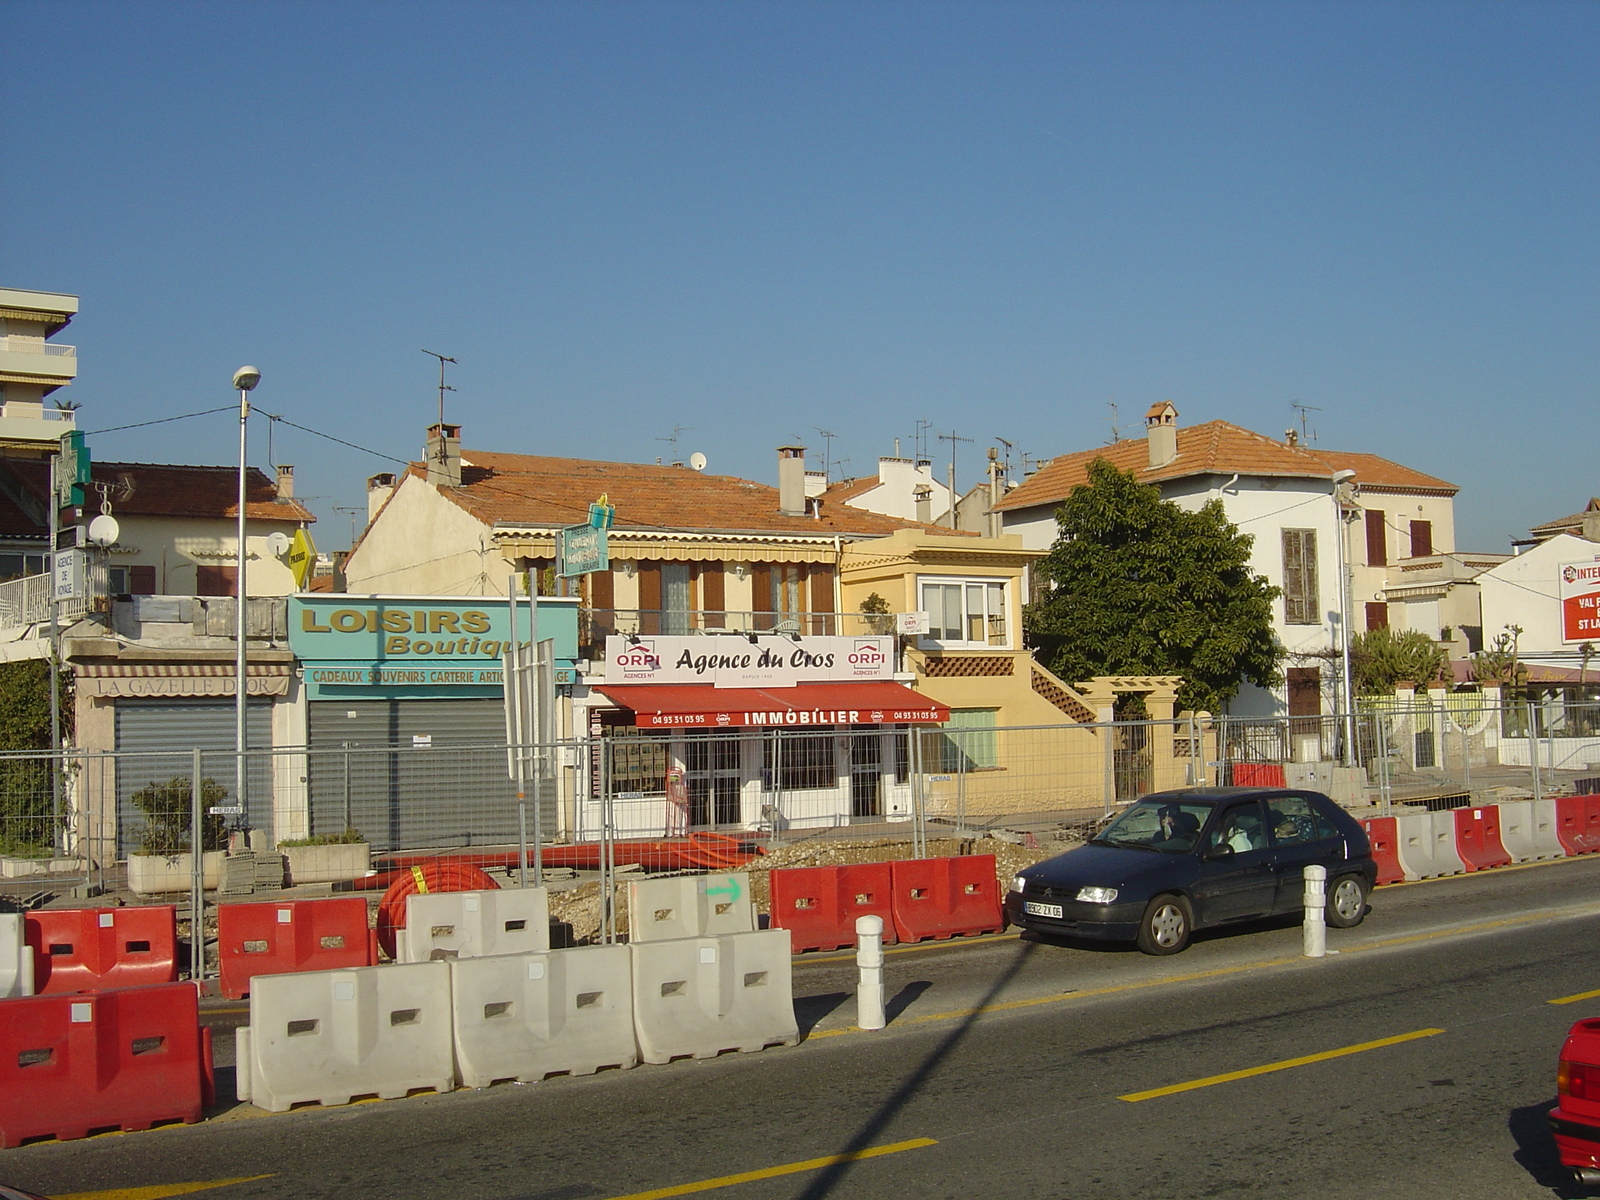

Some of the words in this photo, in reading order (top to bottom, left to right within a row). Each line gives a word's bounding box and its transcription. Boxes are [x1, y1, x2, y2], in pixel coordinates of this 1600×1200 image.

[57, 555, 73, 568] AGENCE
[61, 570, 68, 581] DE
[57, 583, 73, 595] VOYAGE
[1579, 598, 1595, 608] VAL
[302, 609, 491, 633] LOISIRS
[1578, 619, 1589, 630] ST
[384, 636, 533, 658] Boutiqu
[617, 655, 660, 666] ORPI
[675, 649, 751, 675] Agence
[757, 648, 783, 668] du
[790, 648, 835, 668] Cros
[848, 653, 885, 664] ORPI
[312, 670, 363, 683] CADEAUX
[367, 671, 426, 683] SOUVENIRS
[430, 671, 474, 683] CARTERIE
[479, 671, 504, 683] ARTIC
[97, 679, 121, 695] LA
[128, 678, 214, 695] GAZELLE
[652, 716, 662, 725] 04
[663, 716, 673, 724] 93
[674, 715, 684, 724] 31
[684, 715, 694, 723] 03
[695, 715, 705, 723] 95
[744, 711, 859, 725] IMMOBILIER
[921, 711, 929, 719] 03
[930, 711, 938, 719] 95
[1043, 905, 1052, 915] ZX
[1052, 906, 1061, 916] 06
